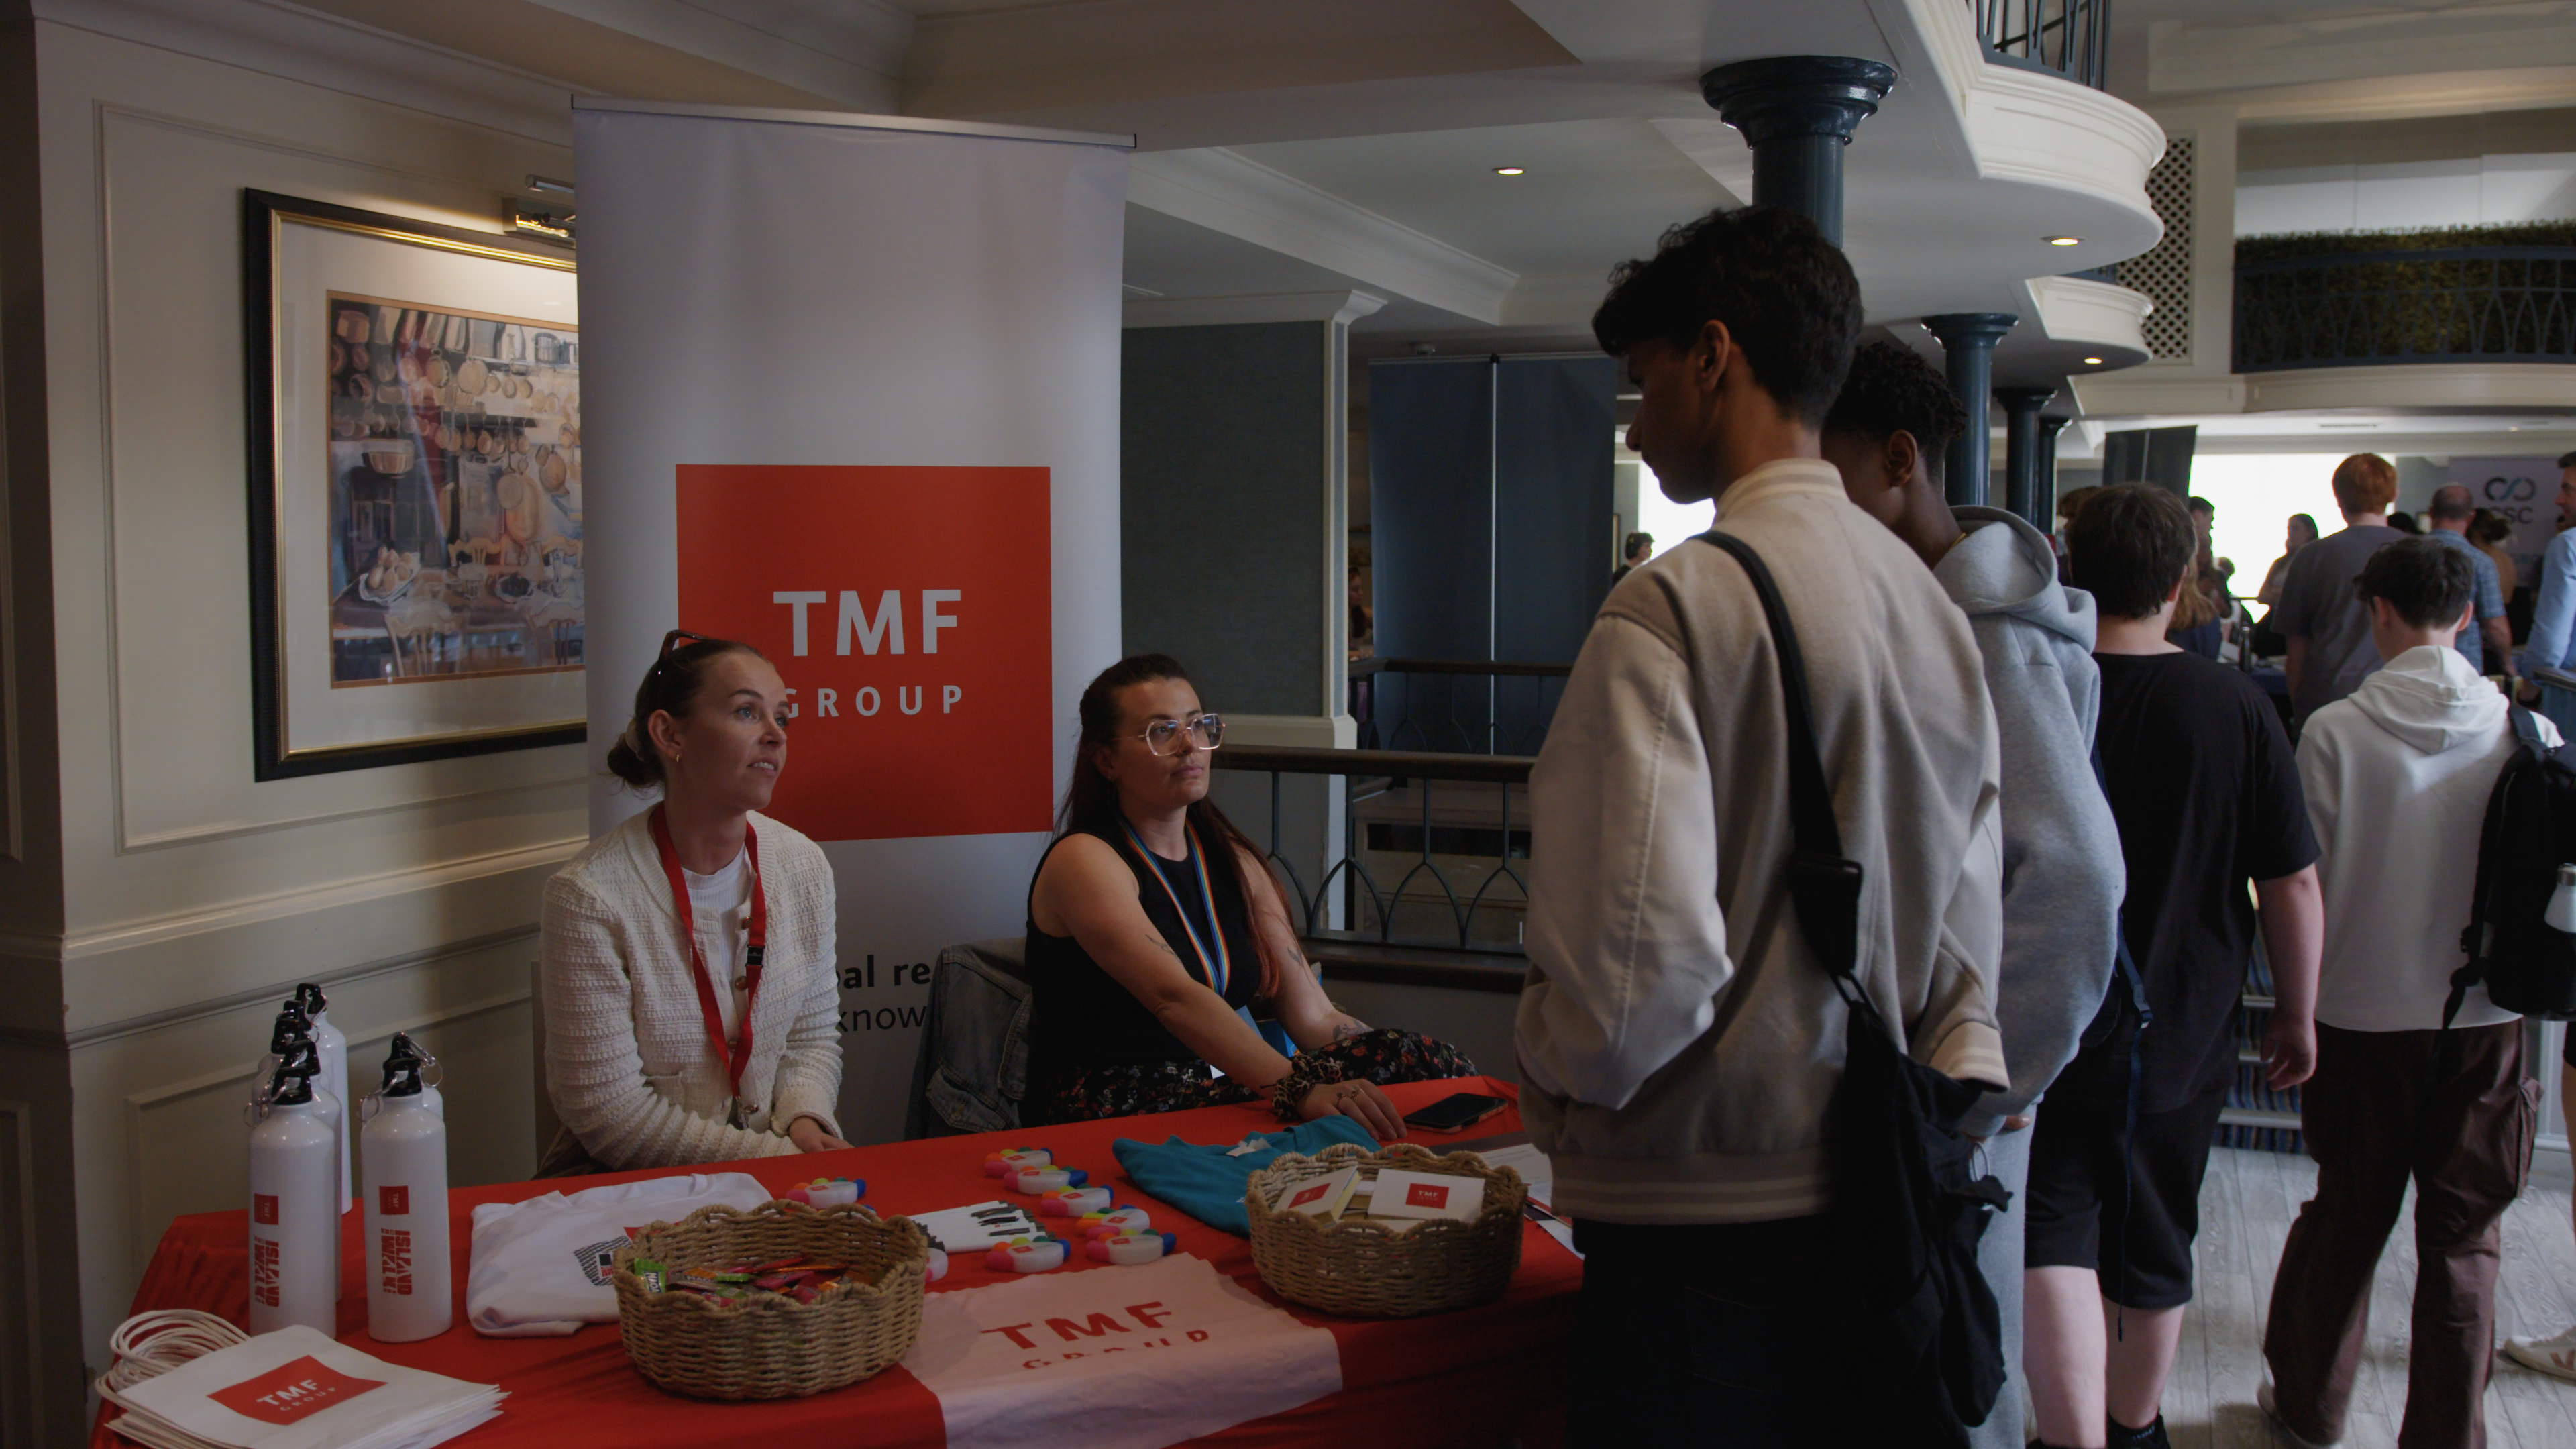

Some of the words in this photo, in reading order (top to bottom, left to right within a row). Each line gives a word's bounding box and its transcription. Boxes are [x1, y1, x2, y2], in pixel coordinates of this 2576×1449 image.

[773, 589, 961, 657] TMF
[837, 955, 875, 989] al
[979, 1301, 1172, 1350] TMF
[256, 1379, 317, 1405] TMF
